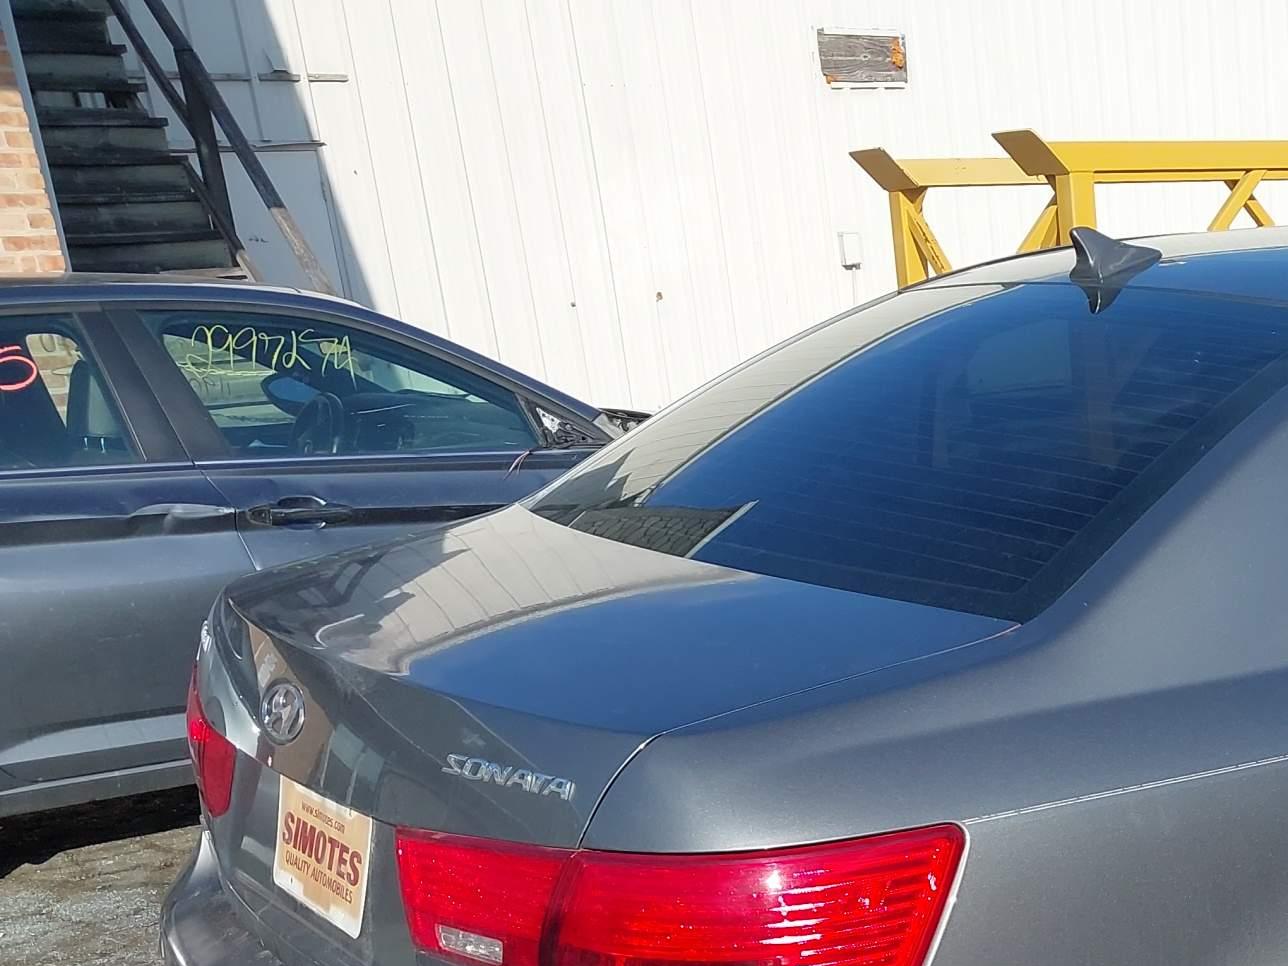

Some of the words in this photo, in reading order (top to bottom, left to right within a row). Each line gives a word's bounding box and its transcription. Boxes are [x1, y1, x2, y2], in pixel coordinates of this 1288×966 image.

[441, 753, 577, 801] SONATA
[282, 811, 363, 887] SIMOTES
[285, 851, 311, 876] QUALITY
[310, 867, 353, 905] AUTOMOBILES
